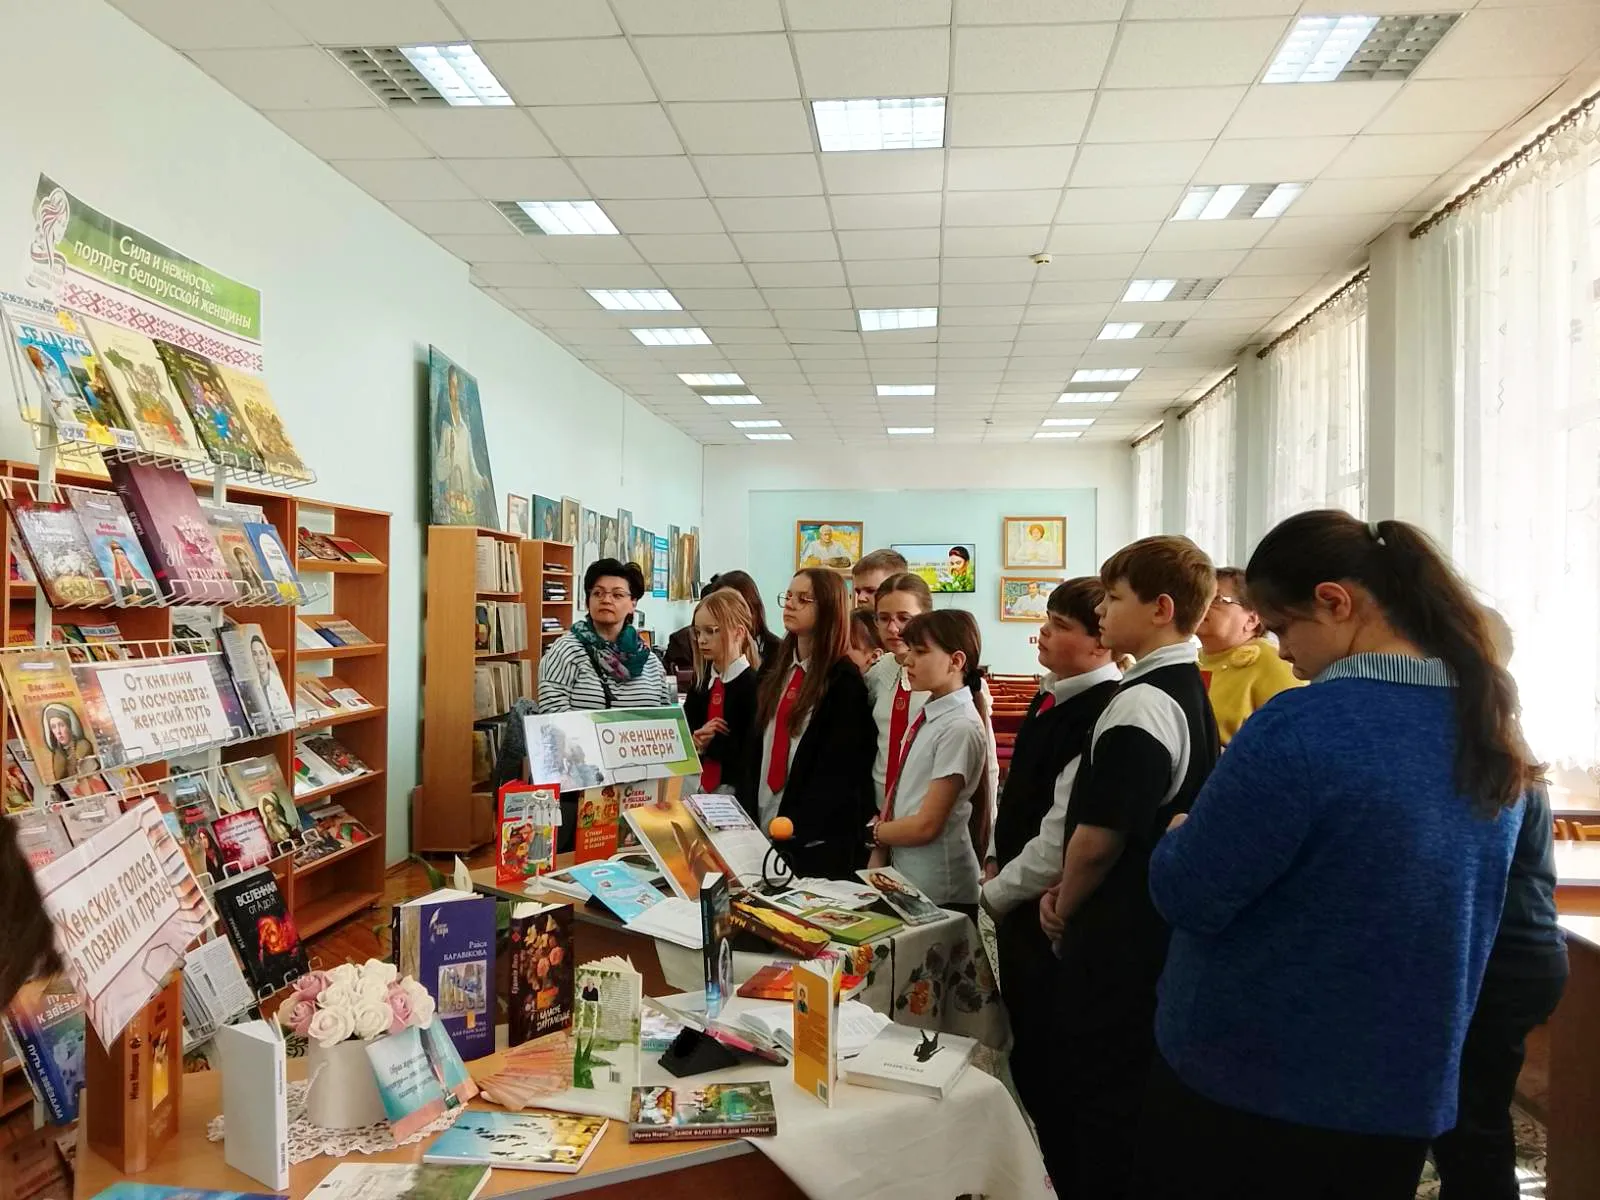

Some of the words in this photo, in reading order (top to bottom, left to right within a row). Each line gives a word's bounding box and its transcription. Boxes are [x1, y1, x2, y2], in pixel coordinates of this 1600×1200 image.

[119, 235, 151, 266] Сила
[152, 254, 160, 270] и
[162, 259, 216, 296] нежность:
[73, 240, 128, 276] портрет
[128, 262, 200, 309] белорусской
[200, 298, 252, 329] женщины
[123, 673, 144, 692] От
[147, 671, 193, 689] княгини
[121, 695, 137, 713] до
[139, 686, 209, 709] космонавта:
[132, 707, 184, 729] женский
[186, 703, 211, 721] путь
[152, 732, 160, 746] в
[162, 723, 209, 744] истории
[601, 728, 615, 745] О
[618, 727, 679, 744] женщине,
[618, 744, 627, 758] о
[630, 742, 674, 759] матери
[56, 884, 121, 950] Женские
[118, 852, 158, 898] голоса
[236, 881, 278, 907] ВСЕЛЕННАЯ
[73, 956, 88, 982] в
[84, 922, 131, 973] поэзии
[126, 908, 141, 932] и
[138, 878, 173, 923] прозе
